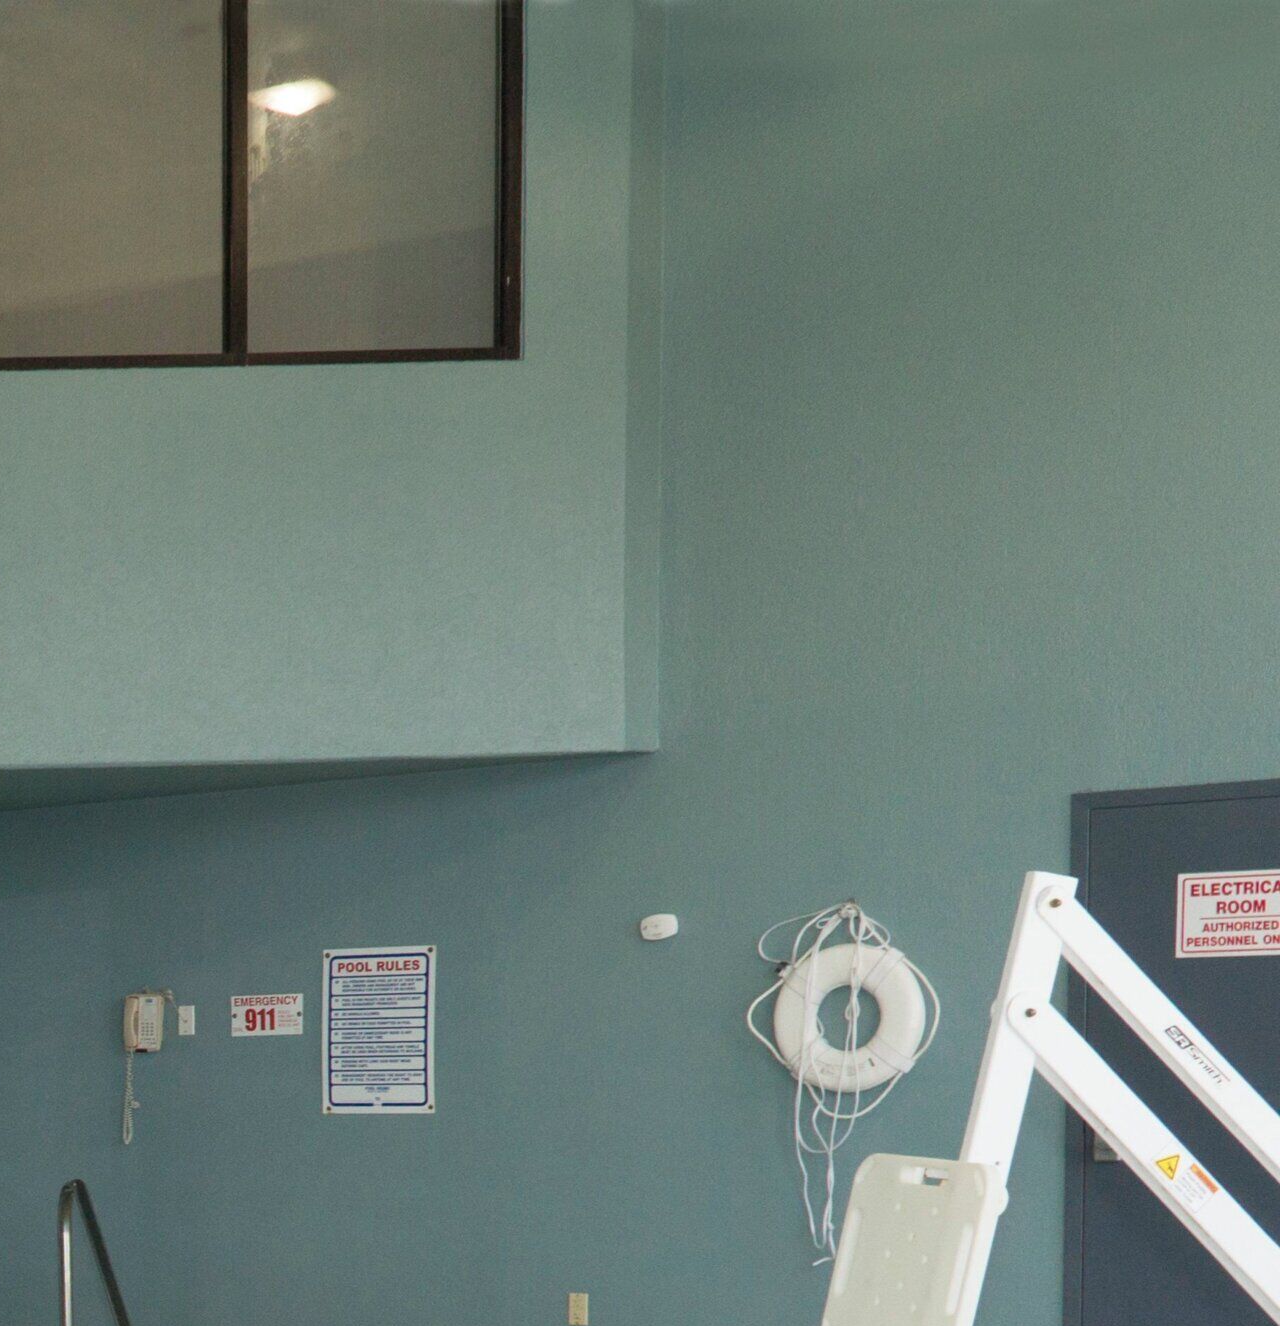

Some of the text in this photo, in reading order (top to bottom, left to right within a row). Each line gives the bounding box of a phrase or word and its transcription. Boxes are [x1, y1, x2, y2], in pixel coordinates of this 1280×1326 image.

[1216, 900, 1266, 914] ROOM
[1202, 920, 1279, 933] AUTHORIZED
[1186, 935, 1258, 947] PERSONNEL
[337, 959, 421, 974] POOL RULES
[233, 995, 299, 1007] EMERGENCY
[245, 1008, 276, 1032] 911
